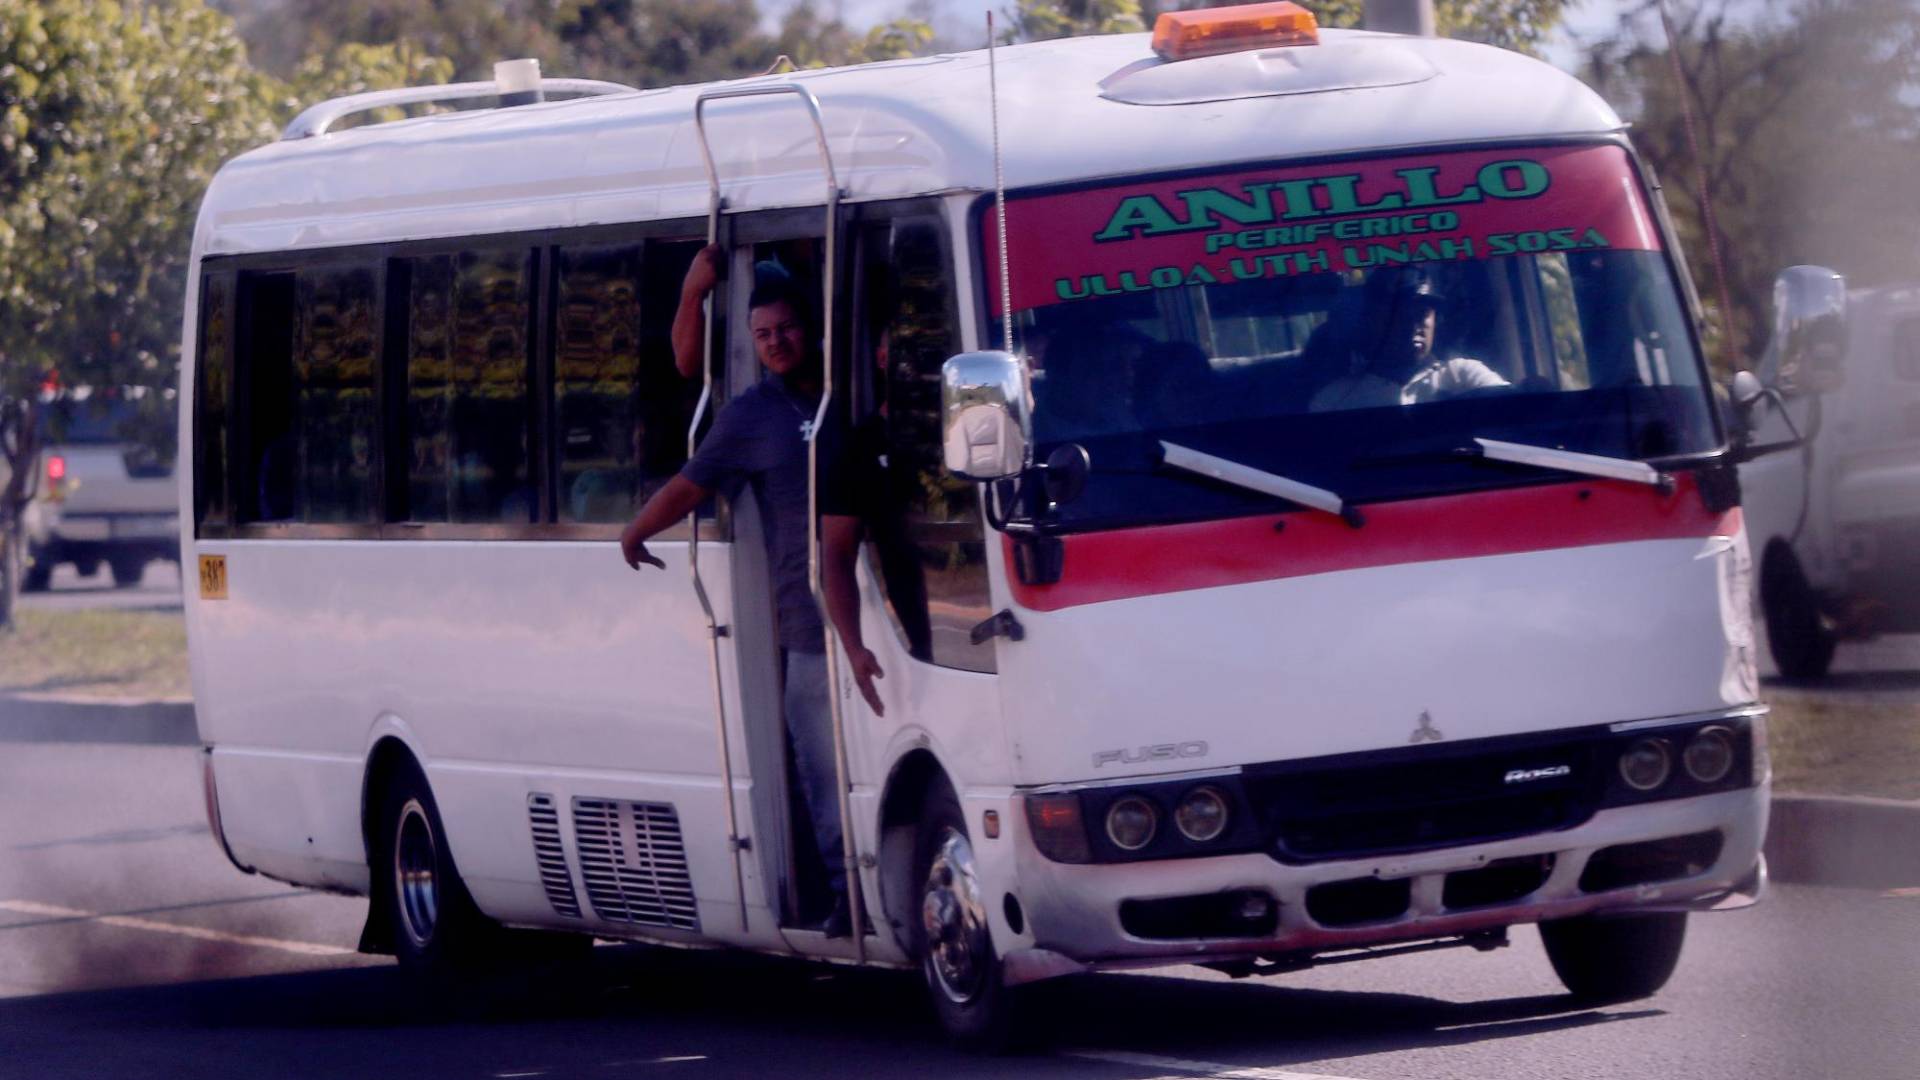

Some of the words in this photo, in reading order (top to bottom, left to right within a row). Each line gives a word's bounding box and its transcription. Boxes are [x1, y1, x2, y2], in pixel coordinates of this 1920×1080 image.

[1095, 159, 1550, 241] ANILLO
[1206, 211, 1459, 254] PERIFERICO
[1343, 236, 1474, 267] UNAH
[1486, 226, 1610, 255] SOSA
[1092, 740, 1208, 768] FUSO
